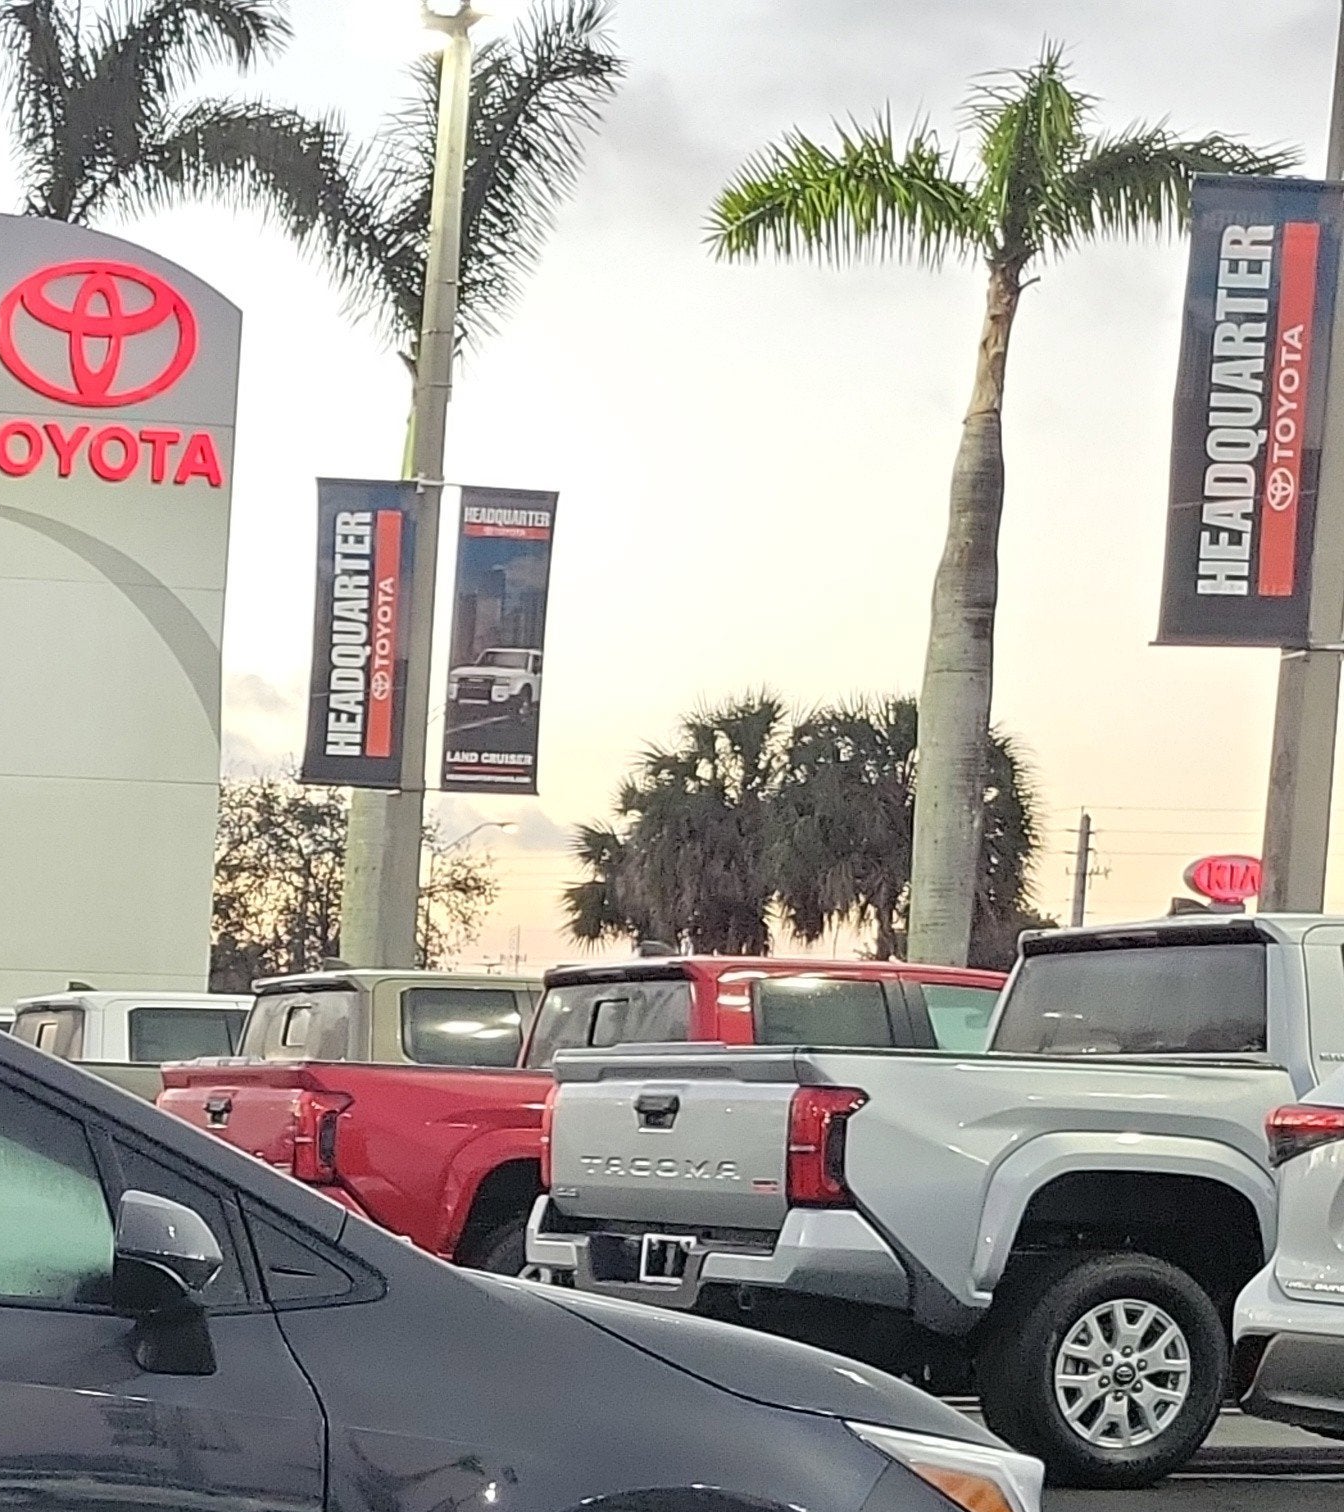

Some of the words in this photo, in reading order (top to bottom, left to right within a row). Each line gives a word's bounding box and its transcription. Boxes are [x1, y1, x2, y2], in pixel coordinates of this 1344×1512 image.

[1196, 224, 1275, 596] HEADQUARTER
[1273, 324, 1304, 463] TOYOTA
[465, 507, 550, 527] HEADQUARTER
[325, 511, 373, 756] HEADQUARTER
[374, 577, 396, 669] TOYOTA
[446, 751, 479, 763] LAND
[480, 752, 533, 765] CRUISER
[580, 1155, 742, 1181] TACOMA
